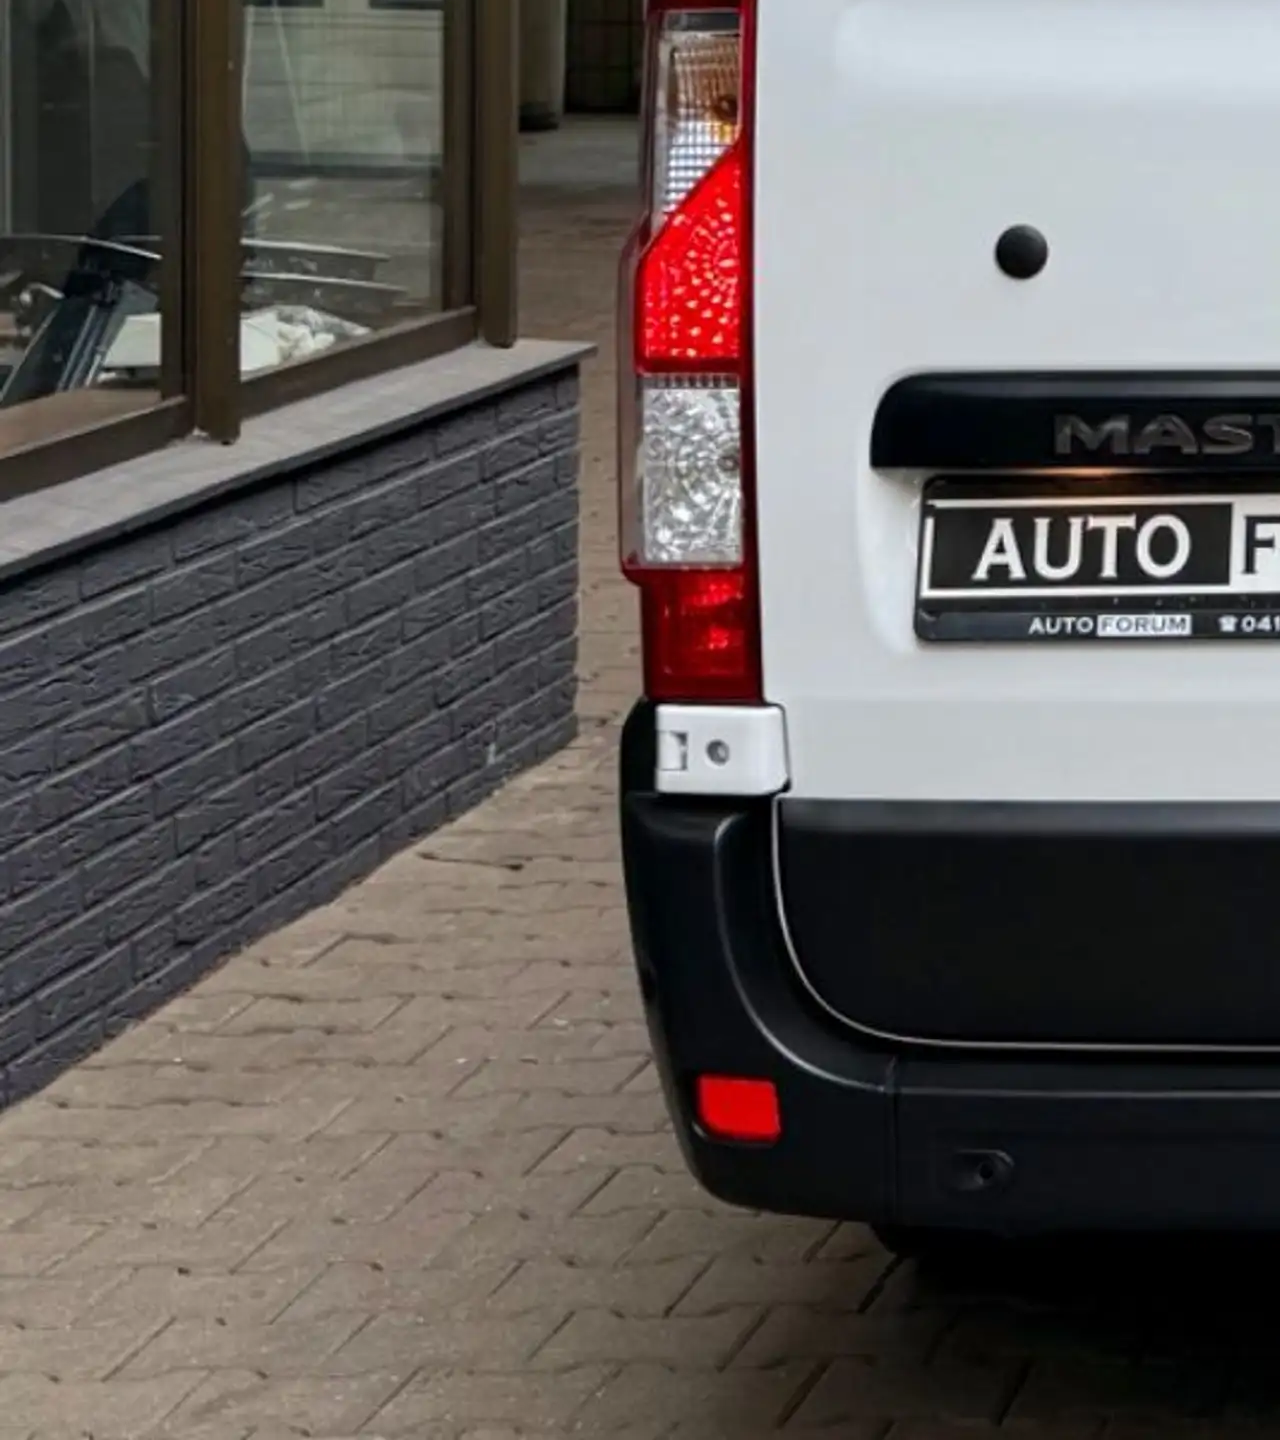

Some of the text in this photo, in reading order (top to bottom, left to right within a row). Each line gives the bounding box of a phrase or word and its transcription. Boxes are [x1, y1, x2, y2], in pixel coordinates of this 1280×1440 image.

[970, 514, 1192, 581] AUTO
[1028, 616, 1094, 635] AUTO
[1101, 616, 1189, 635] FORUM
